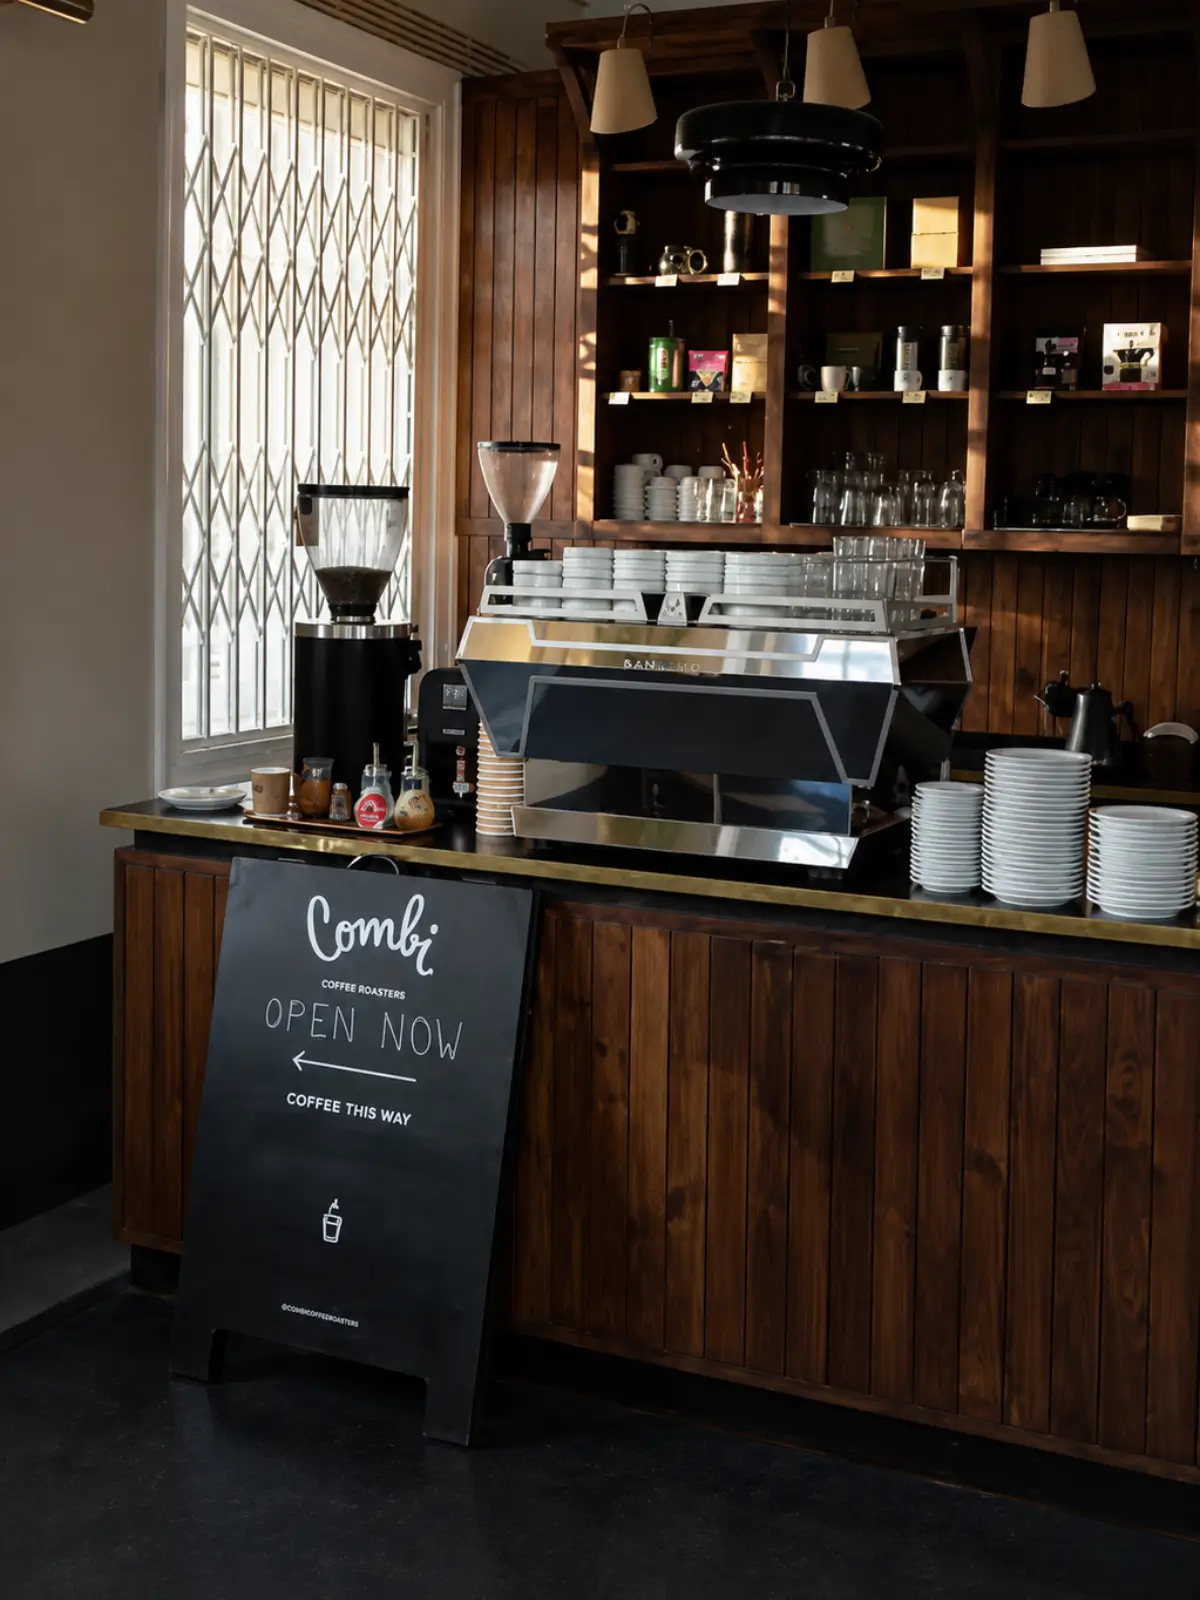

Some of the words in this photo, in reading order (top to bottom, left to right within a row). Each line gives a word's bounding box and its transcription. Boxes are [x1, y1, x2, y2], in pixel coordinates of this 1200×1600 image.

[307, 894, 438, 976] Combi
[321, 979, 357, 993] COFFEE
[358, 984, 406, 1000] ROASTERS
[265, 998, 355, 1042] OPEN
[381, 1012, 463, 1060] NOW
[286, 1092, 341, 1114] COFFEE
[345, 1102, 377, 1121] THIS
[380, 1109, 412, 1127] WAY
